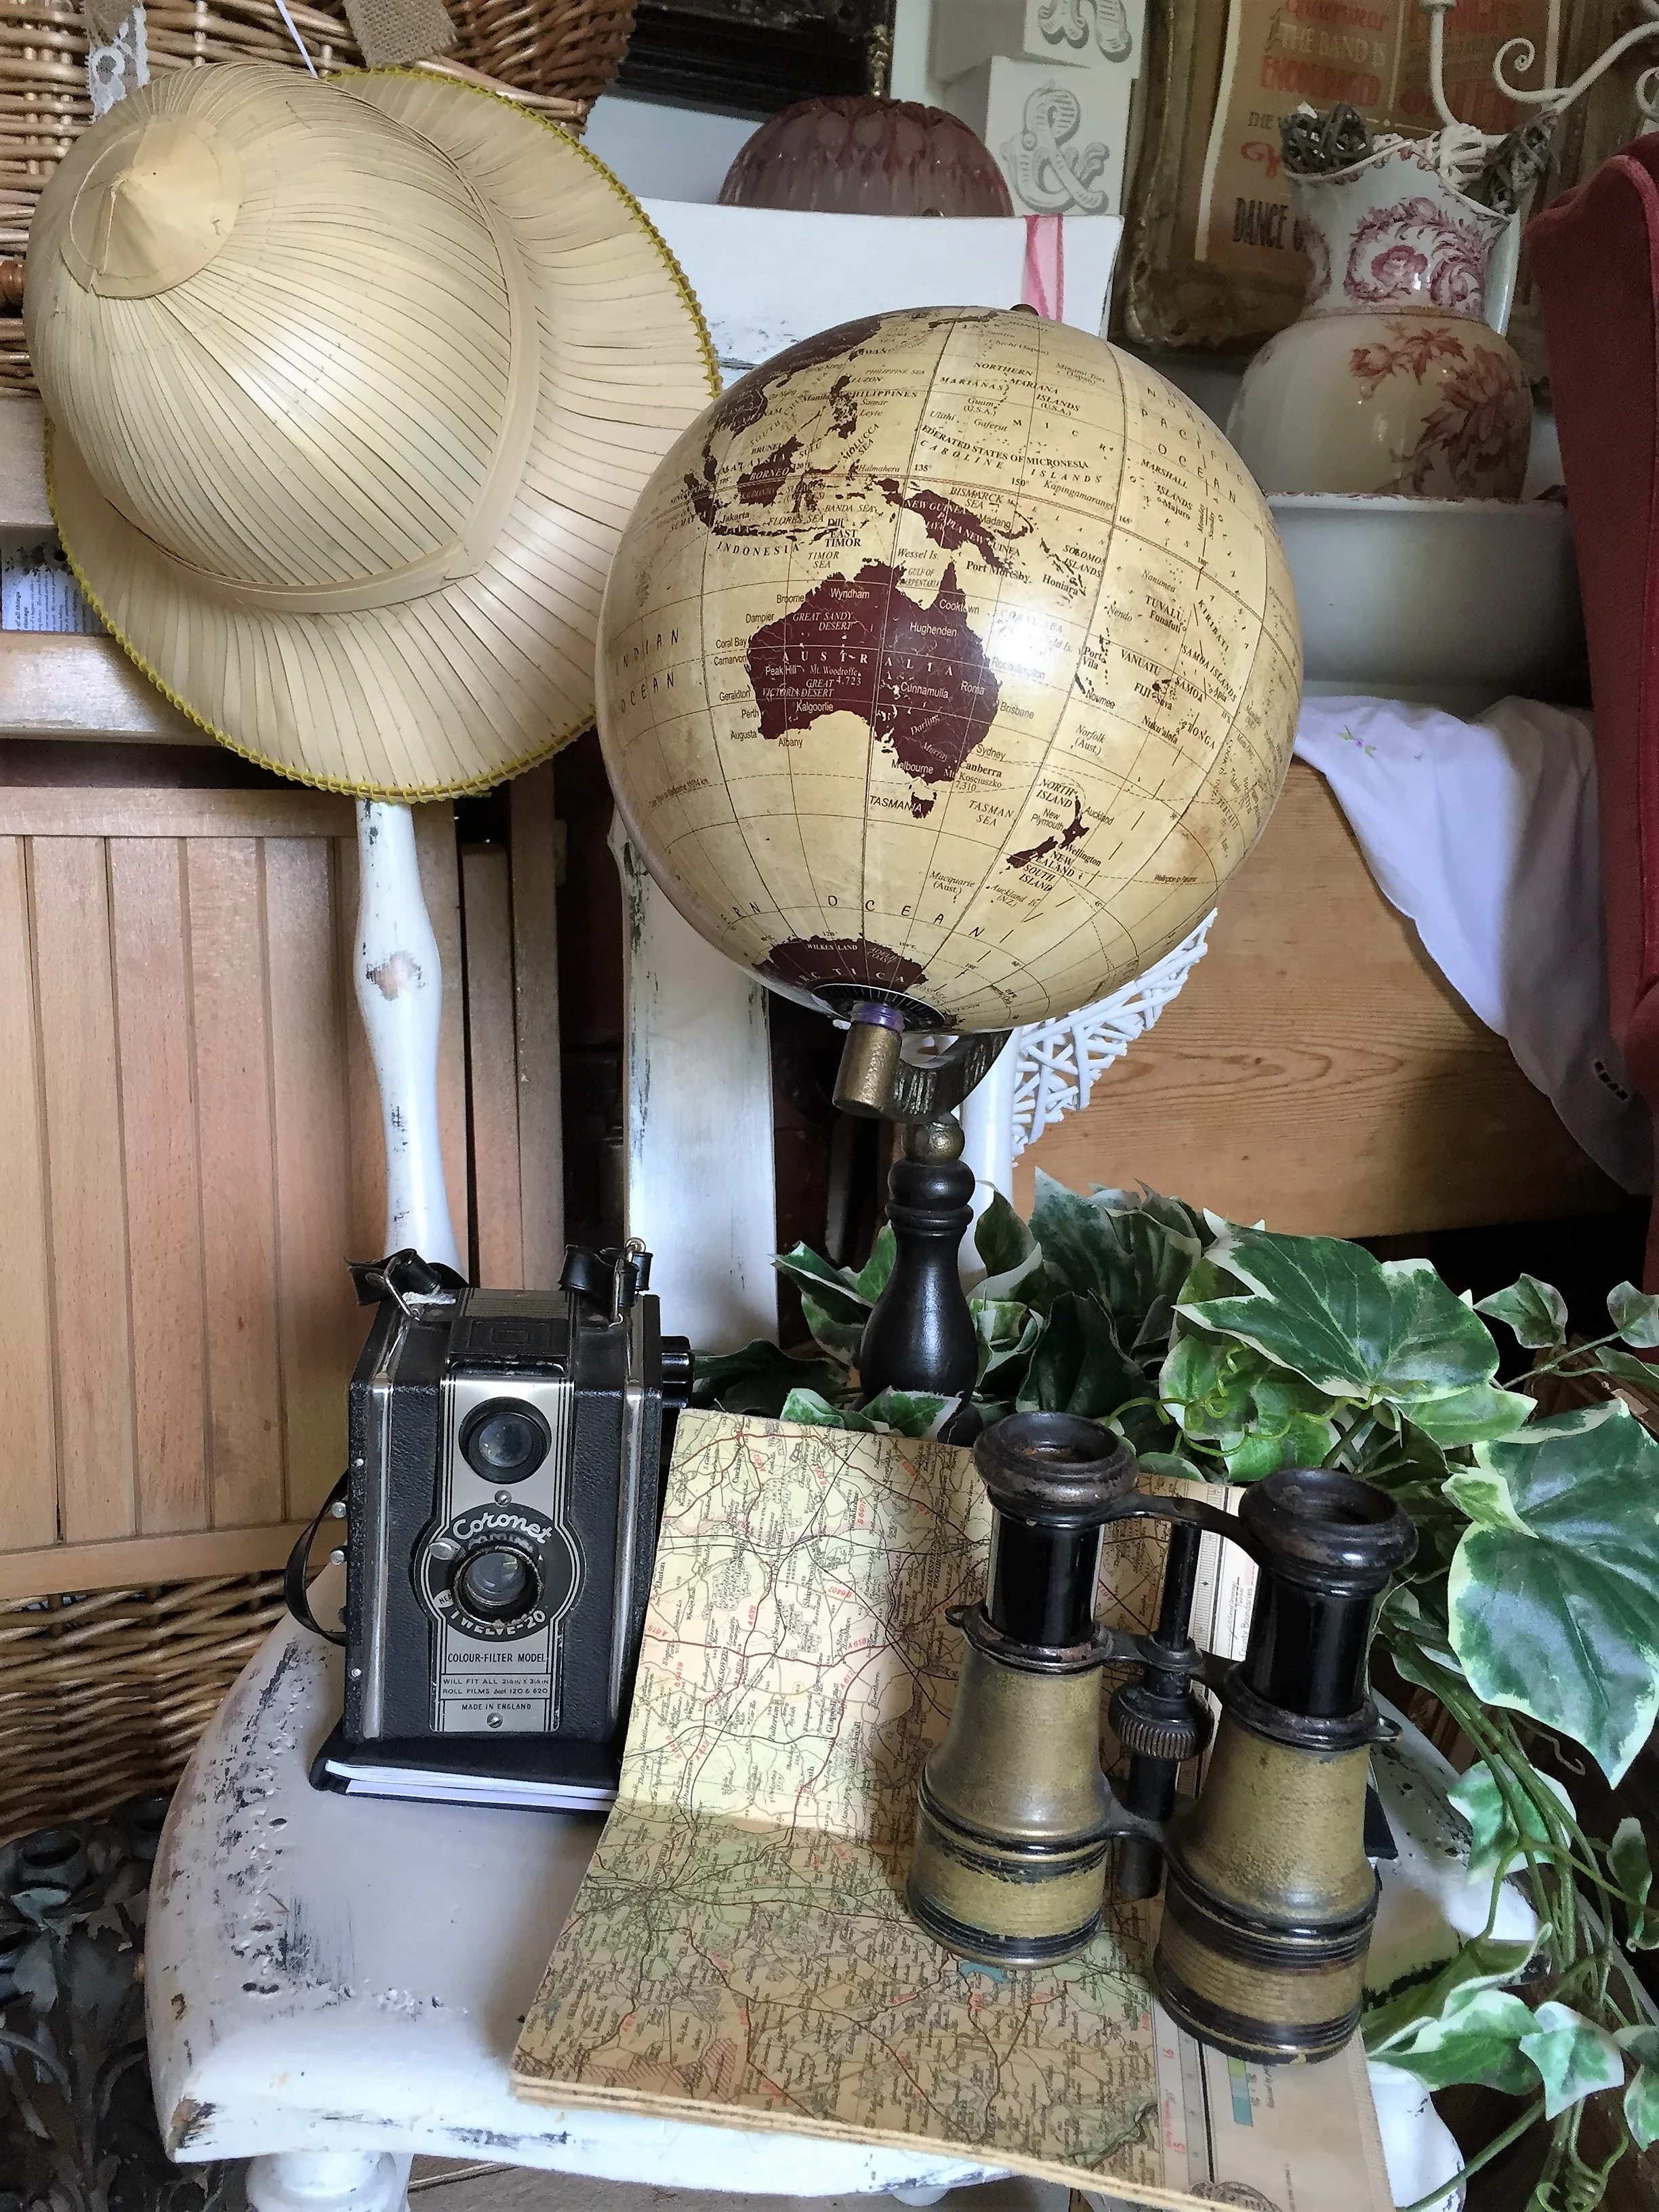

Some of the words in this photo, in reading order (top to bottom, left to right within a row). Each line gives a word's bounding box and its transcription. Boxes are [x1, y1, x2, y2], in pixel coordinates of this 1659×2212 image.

[1233, 197, 1289, 250] DANCE
[974, 362, 1033, 377] NORTHERN
[940, 377, 1004, 392] MARIANAS
[1009, 378, 1058, 394] MARIANA
[963, 405, 996, 416] (U.S.A.)
[968, 397, 994, 407] Guam
[1036, 393, 1081, 413] ISLANDS
[859, 409, 882, 417] Leyte
[930, 410, 955, 422] Ulithi
[973, 418, 1008, 432] Gaferut
[842, 423, 880, 460] MOLUCCA
[859, 439, 874, 455] SEA
[799, 443, 823, 459] SULU
[972, 445, 1008, 460] STATES
[1010, 455, 1025, 463] OF
[1026, 456, 1089, 469] MICRONESIA
[859, 464, 900, 472] Halmahera
[920, 439, 1004, 469] CAROLINE
[1030, 468, 1103, 483] ISLANDS
[750, 467, 790, 480] BORNEO
[1141, 458, 1187, 489] MARSHALL
[950, 487, 1004, 504] BISMARCK
[1043, 480, 1115, 510] Kapingamarangi
[1156, 485, 1193, 510] ISLANDS
[906, 499, 926, 509] NEW
[929, 502, 967, 515] GUINEA
[965, 498, 984, 510] SEA
[1162, 499, 1191, 520] Majuro
[723, 512, 750, 523] Jakarta
[807, 514, 823, 523] SEA
[979, 516, 1011, 530] Madang
[830, 529, 858, 537] EAST
[717, 541, 800, 556] INDONESIA
[825, 538, 861, 547] TIMOR
[964, 529, 985, 544] NEW
[986, 541, 1020, 557] GUINEA
[808, 552, 840, 560] TIMOR
[897, 548, 926, 560] Wessel
[813, 560, 832, 569] SEA
[966, 560, 987, 573] Port
[988, 565, 1031, 584] Moresby
[1042, 573, 1079, 596] Honiara
[777, 594, 804, 603] Broome
[831, 588, 869, 600] Wyndham
[1108, 605, 1133, 622] Nendo
[1145, 594, 1183, 621] TUVALU
[745, 613, 775, 623] Dampier
[793, 612, 821, 622] GREAT
[824, 611, 853, 621] SANDY
[1149, 609, 1181, 634] Funafuti
[819, 621, 853, 631] DESERT
[909, 622, 957, 637] Hughenden
[1198, 599, 1229, 652] KIRIBATI
[615, 628, 679, 676] INDIAN
[716, 640, 733, 649] Coral
[735, 638, 747, 648] Bay
[714, 655, 747, 665] Carnarvon
[781, 649, 954, 677] AUSTRALIA
[1121, 649, 1162, 677] VANUATU
[765, 666, 783, 676] Peak
[785, 665, 797, 674] Hill
[1181, 643, 1210, 670] SAMOA
[1209, 663, 1237, 703] ISLANDS
[806, 678, 834, 688] GREAT
[900, 682, 949, 699] Cunnamulla
[960, 680, 985, 695] Roma
[1133, 682, 1151, 698] FIJI
[1174, 676, 1203, 703] SAMOA
[621, 672, 674, 713] OCEAN
[720, 689, 751, 701] Geraldton
[801, 689, 834, 697] DESERT
[1086, 689, 1115, 710] Noumea
[741, 710, 759, 720] Perth
[796, 701, 834, 714] Kalgoorlie
[1000, 701, 1035, 720] Brisbane
[910, 713, 940, 736] Darling
[1141, 714, 1178, 744] Nuku'alofa
[731, 730, 757, 741] Augusta
[1076, 724, 1106, 743] Norfolk
[1187, 721, 1216, 750] TONGA
[779, 737, 803, 749] Albany
[1075, 737, 1102, 756] (Aust.)
[977, 743, 1006, 762] Sydney
[890, 758, 934, 775] Melbourne
[959, 760, 1002, 778] Canberra
[958, 772, 1002, 789] Kosciuszko
[1040, 777, 1074, 797] NORTH
[869, 795, 923, 812] TASMANIA
[1036, 789, 1072, 808] ISLAND
[969, 799, 1015, 818] TASMAN
[1042, 808, 1061, 821] New
[1084, 806, 1115, 825] Auckland
[977, 815, 997, 827] SEA
[1031, 813, 1064, 832] Plymouth
[1050, 851, 1073, 865] NEW
[1063, 843, 1102, 867] Wellington
[929, 870, 976, 888] Macquarie
[1023, 863, 1055, 882] SOUTH
[933, 880, 963, 895] (Aust.)
[1019, 873, 1053, 893] ISLAND
[990, 883, 1028, 904] Auckland
[733, 1452, 745, 1484] Cuckney
[453, 1512, 552, 1544] Coronet
[1241, 1588, 1252, 1629] Boundaries
[854, 1637, 868, 1647] 618
[448, 1653, 513, 1662] COLOUR-FILTER
[518, 1653, 546, 1662] MODEL
[826, 1700, 837, 1733] Glapwell
